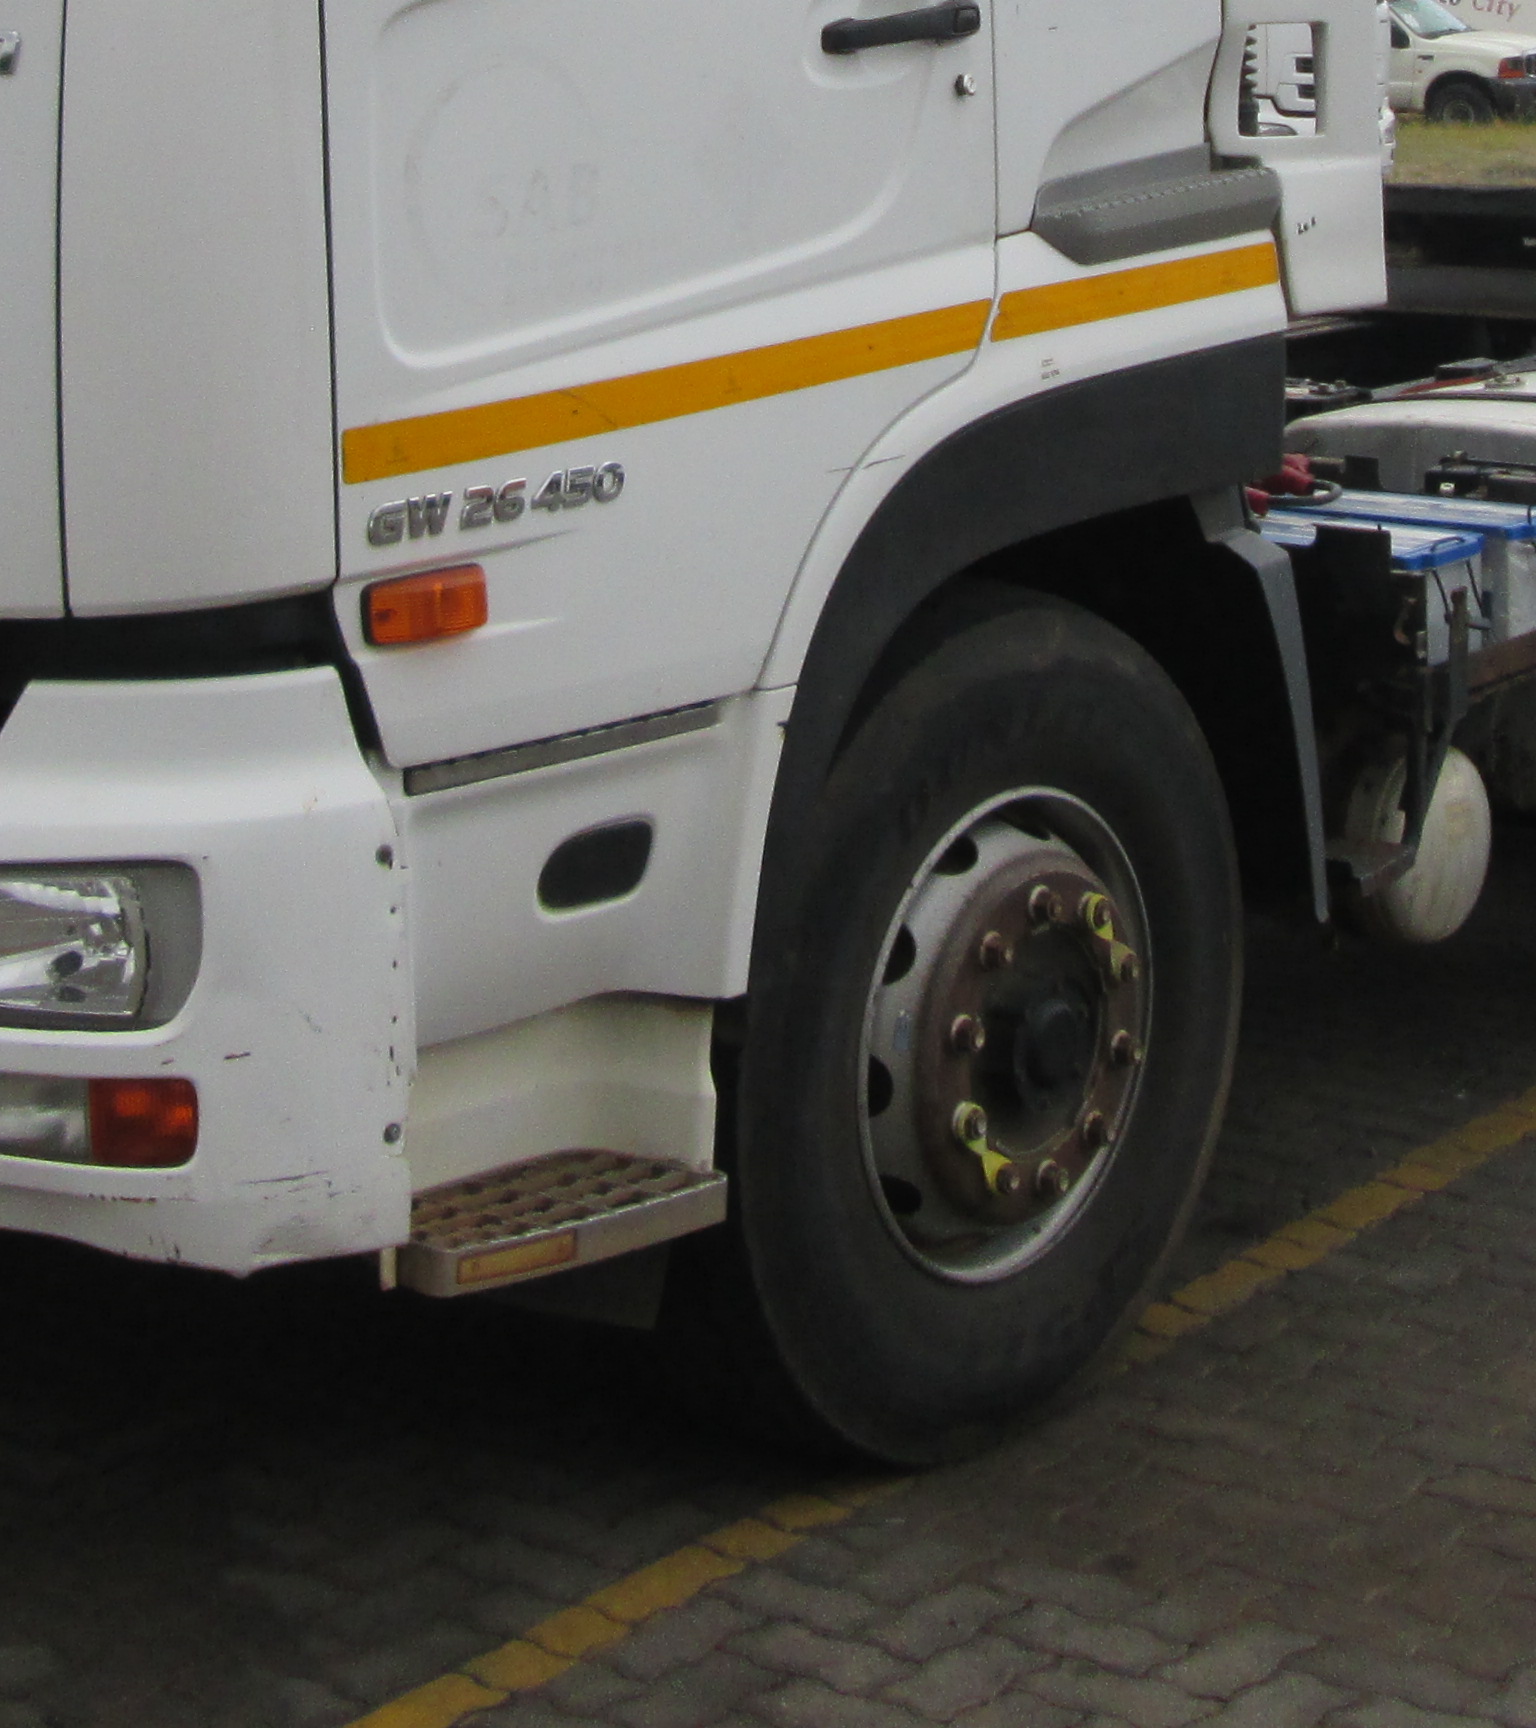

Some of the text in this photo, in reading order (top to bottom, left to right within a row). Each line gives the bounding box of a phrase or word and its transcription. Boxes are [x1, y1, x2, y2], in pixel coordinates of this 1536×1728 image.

[368, 461, 626, 546] GW 26 450
